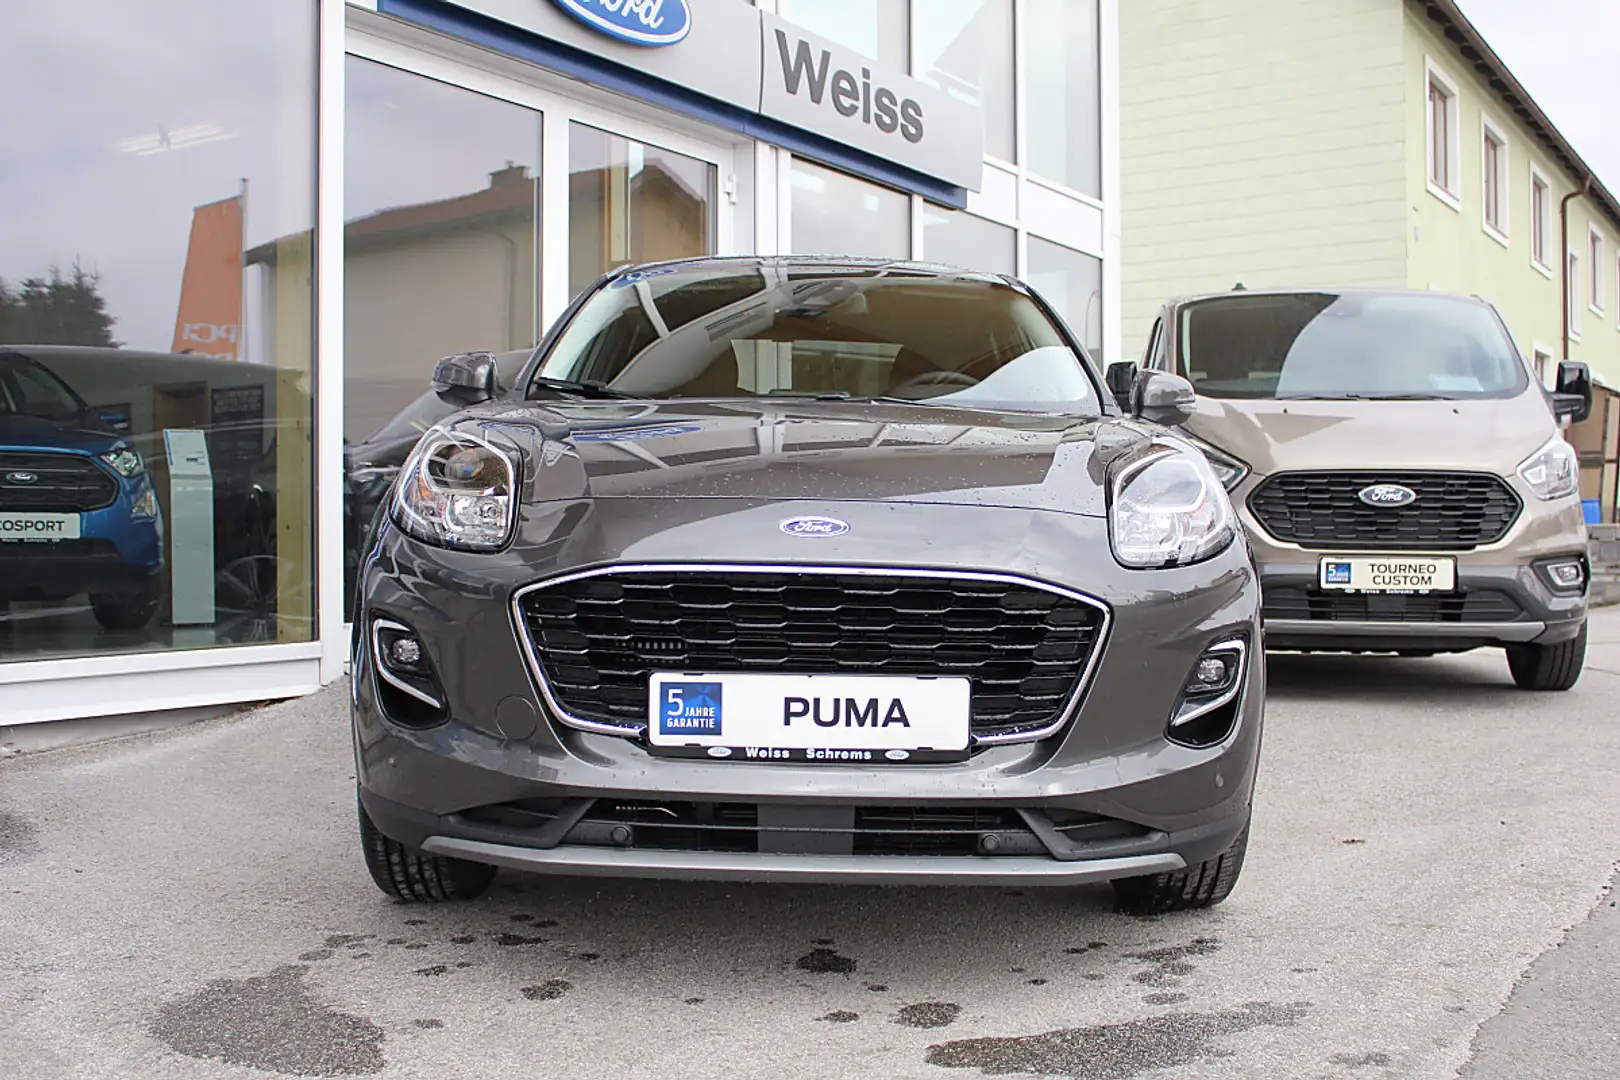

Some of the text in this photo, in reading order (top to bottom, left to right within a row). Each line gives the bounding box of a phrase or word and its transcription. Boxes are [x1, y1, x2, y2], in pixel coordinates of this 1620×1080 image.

[774, 28, 923, 143] Weiss
[1371, 487, 1405, 501] Ford
[0, 519, 65, 532] OSPORT
[1369, 563, 1437, 574] TOURNEO
[1372, 575, 1432, 586] CUSTOM
[667, 688, 715, 717] 5 JAHRE
[783, 696, 911, 728] PUMA
[667, 718, 716, 728] GARANTIE
[745, 747, 872, 760] Weiss Schrems
